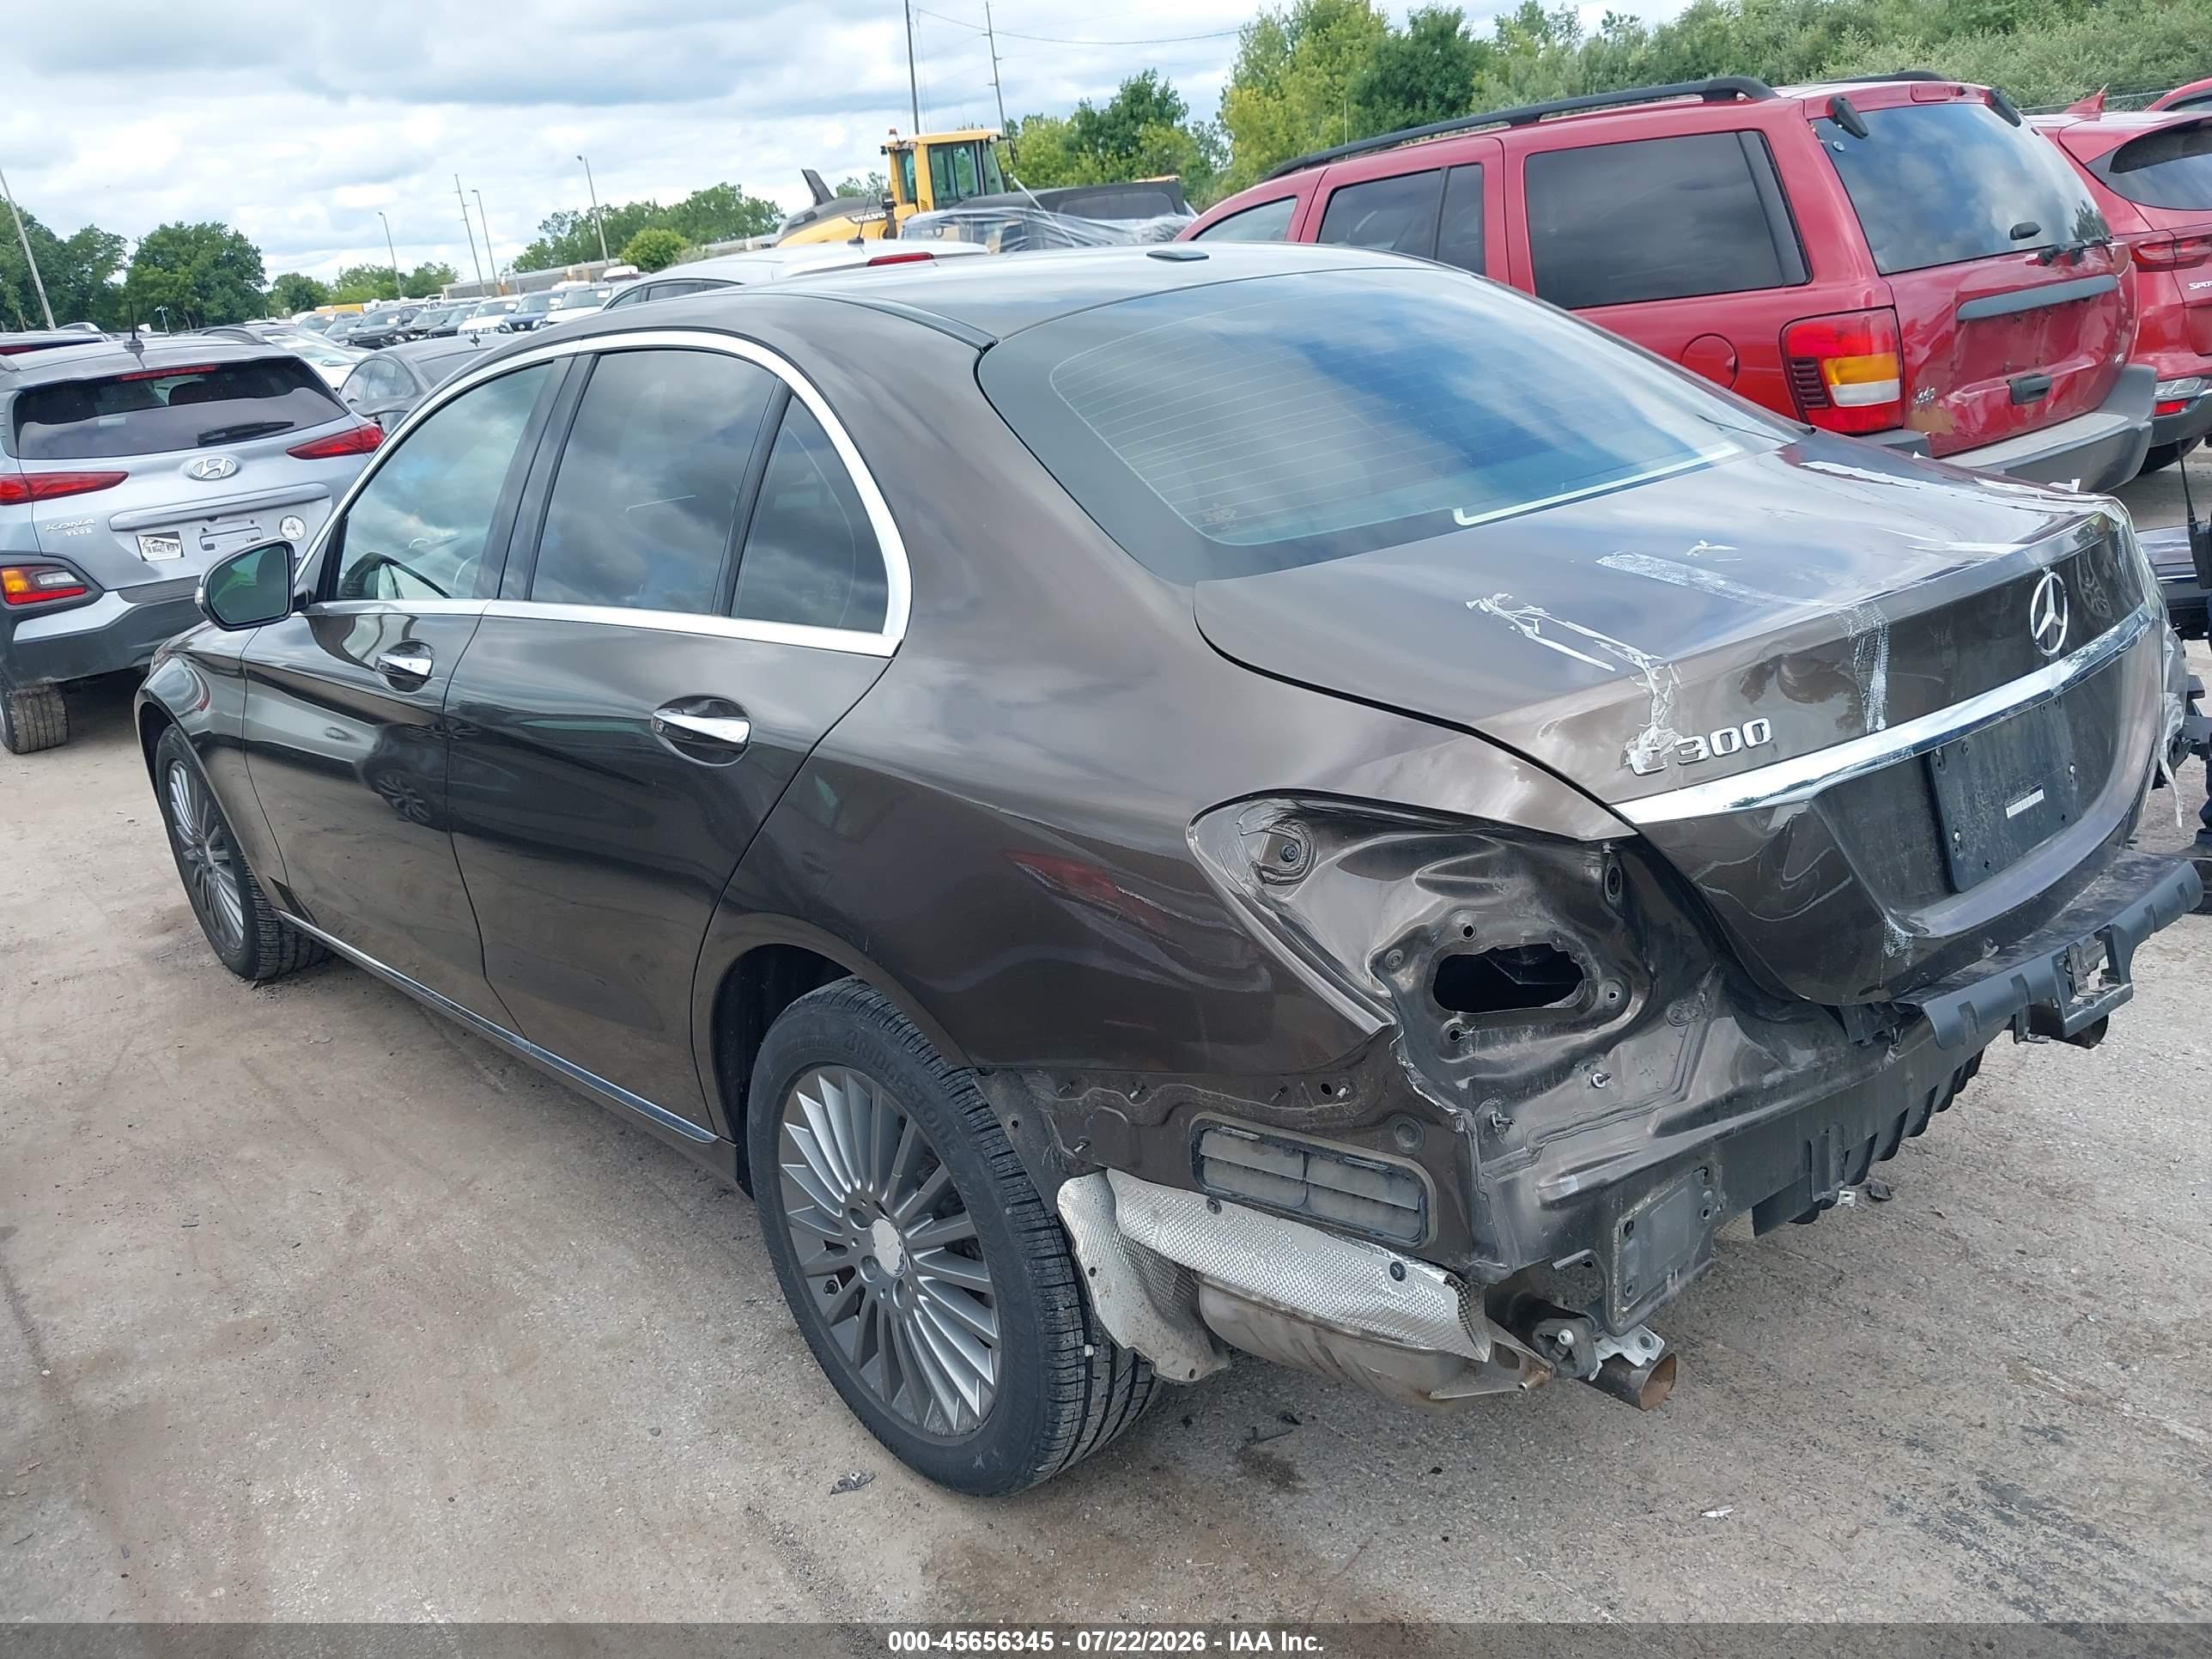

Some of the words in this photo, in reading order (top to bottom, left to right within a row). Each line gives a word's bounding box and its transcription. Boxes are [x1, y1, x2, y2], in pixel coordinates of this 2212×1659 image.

[852, 212, 886, 222] VOLVO
[2188, 281, 2212, 290] SPO
[46, 518, 96, 532] KONA
[1675, 717, 1773, 766] 300
